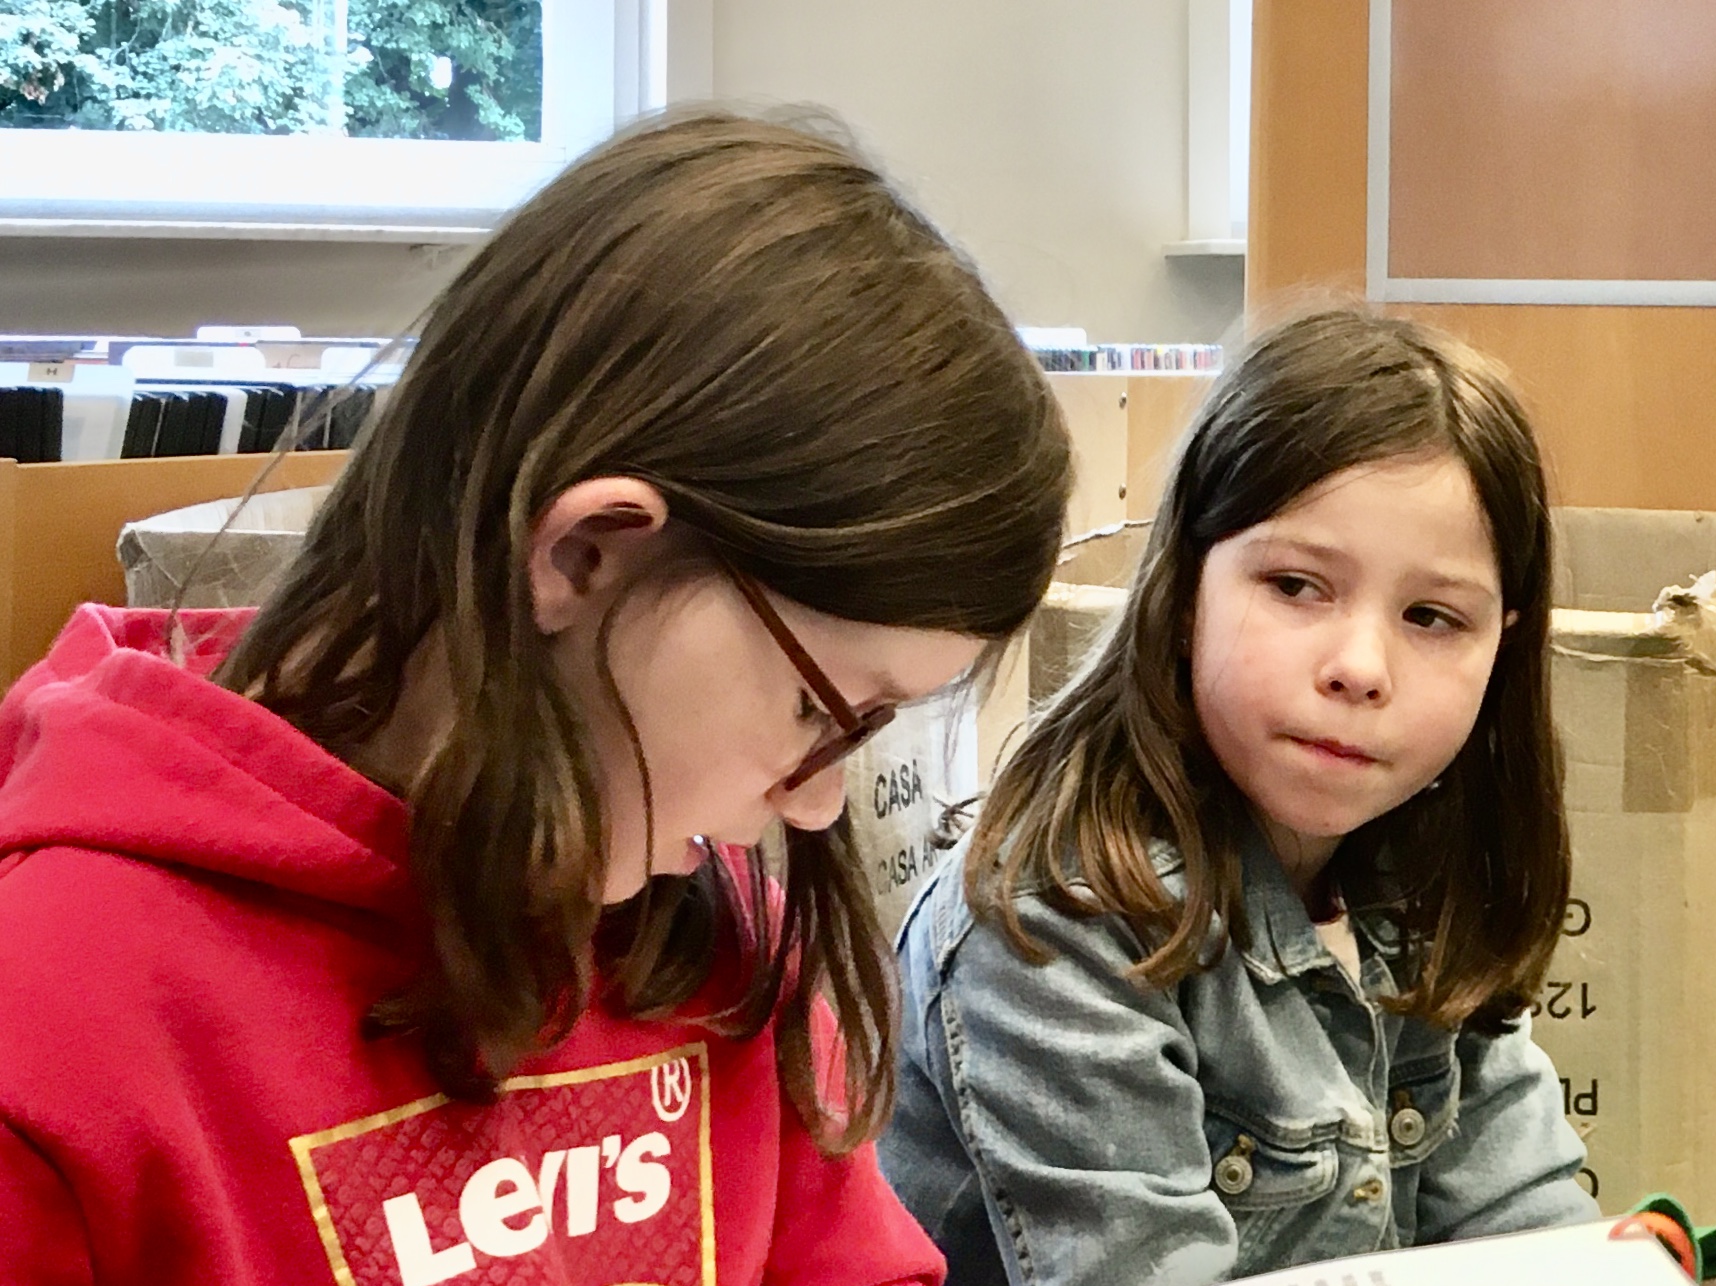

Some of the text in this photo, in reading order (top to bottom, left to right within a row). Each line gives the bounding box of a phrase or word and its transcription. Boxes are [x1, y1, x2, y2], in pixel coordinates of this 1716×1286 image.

[873, 758, 923, 820] CASA
[876, 845, 918, 896] CASA
[1530, 982, 1597, 1019] 12
[1560, 1078, 1598, 1116] PL
